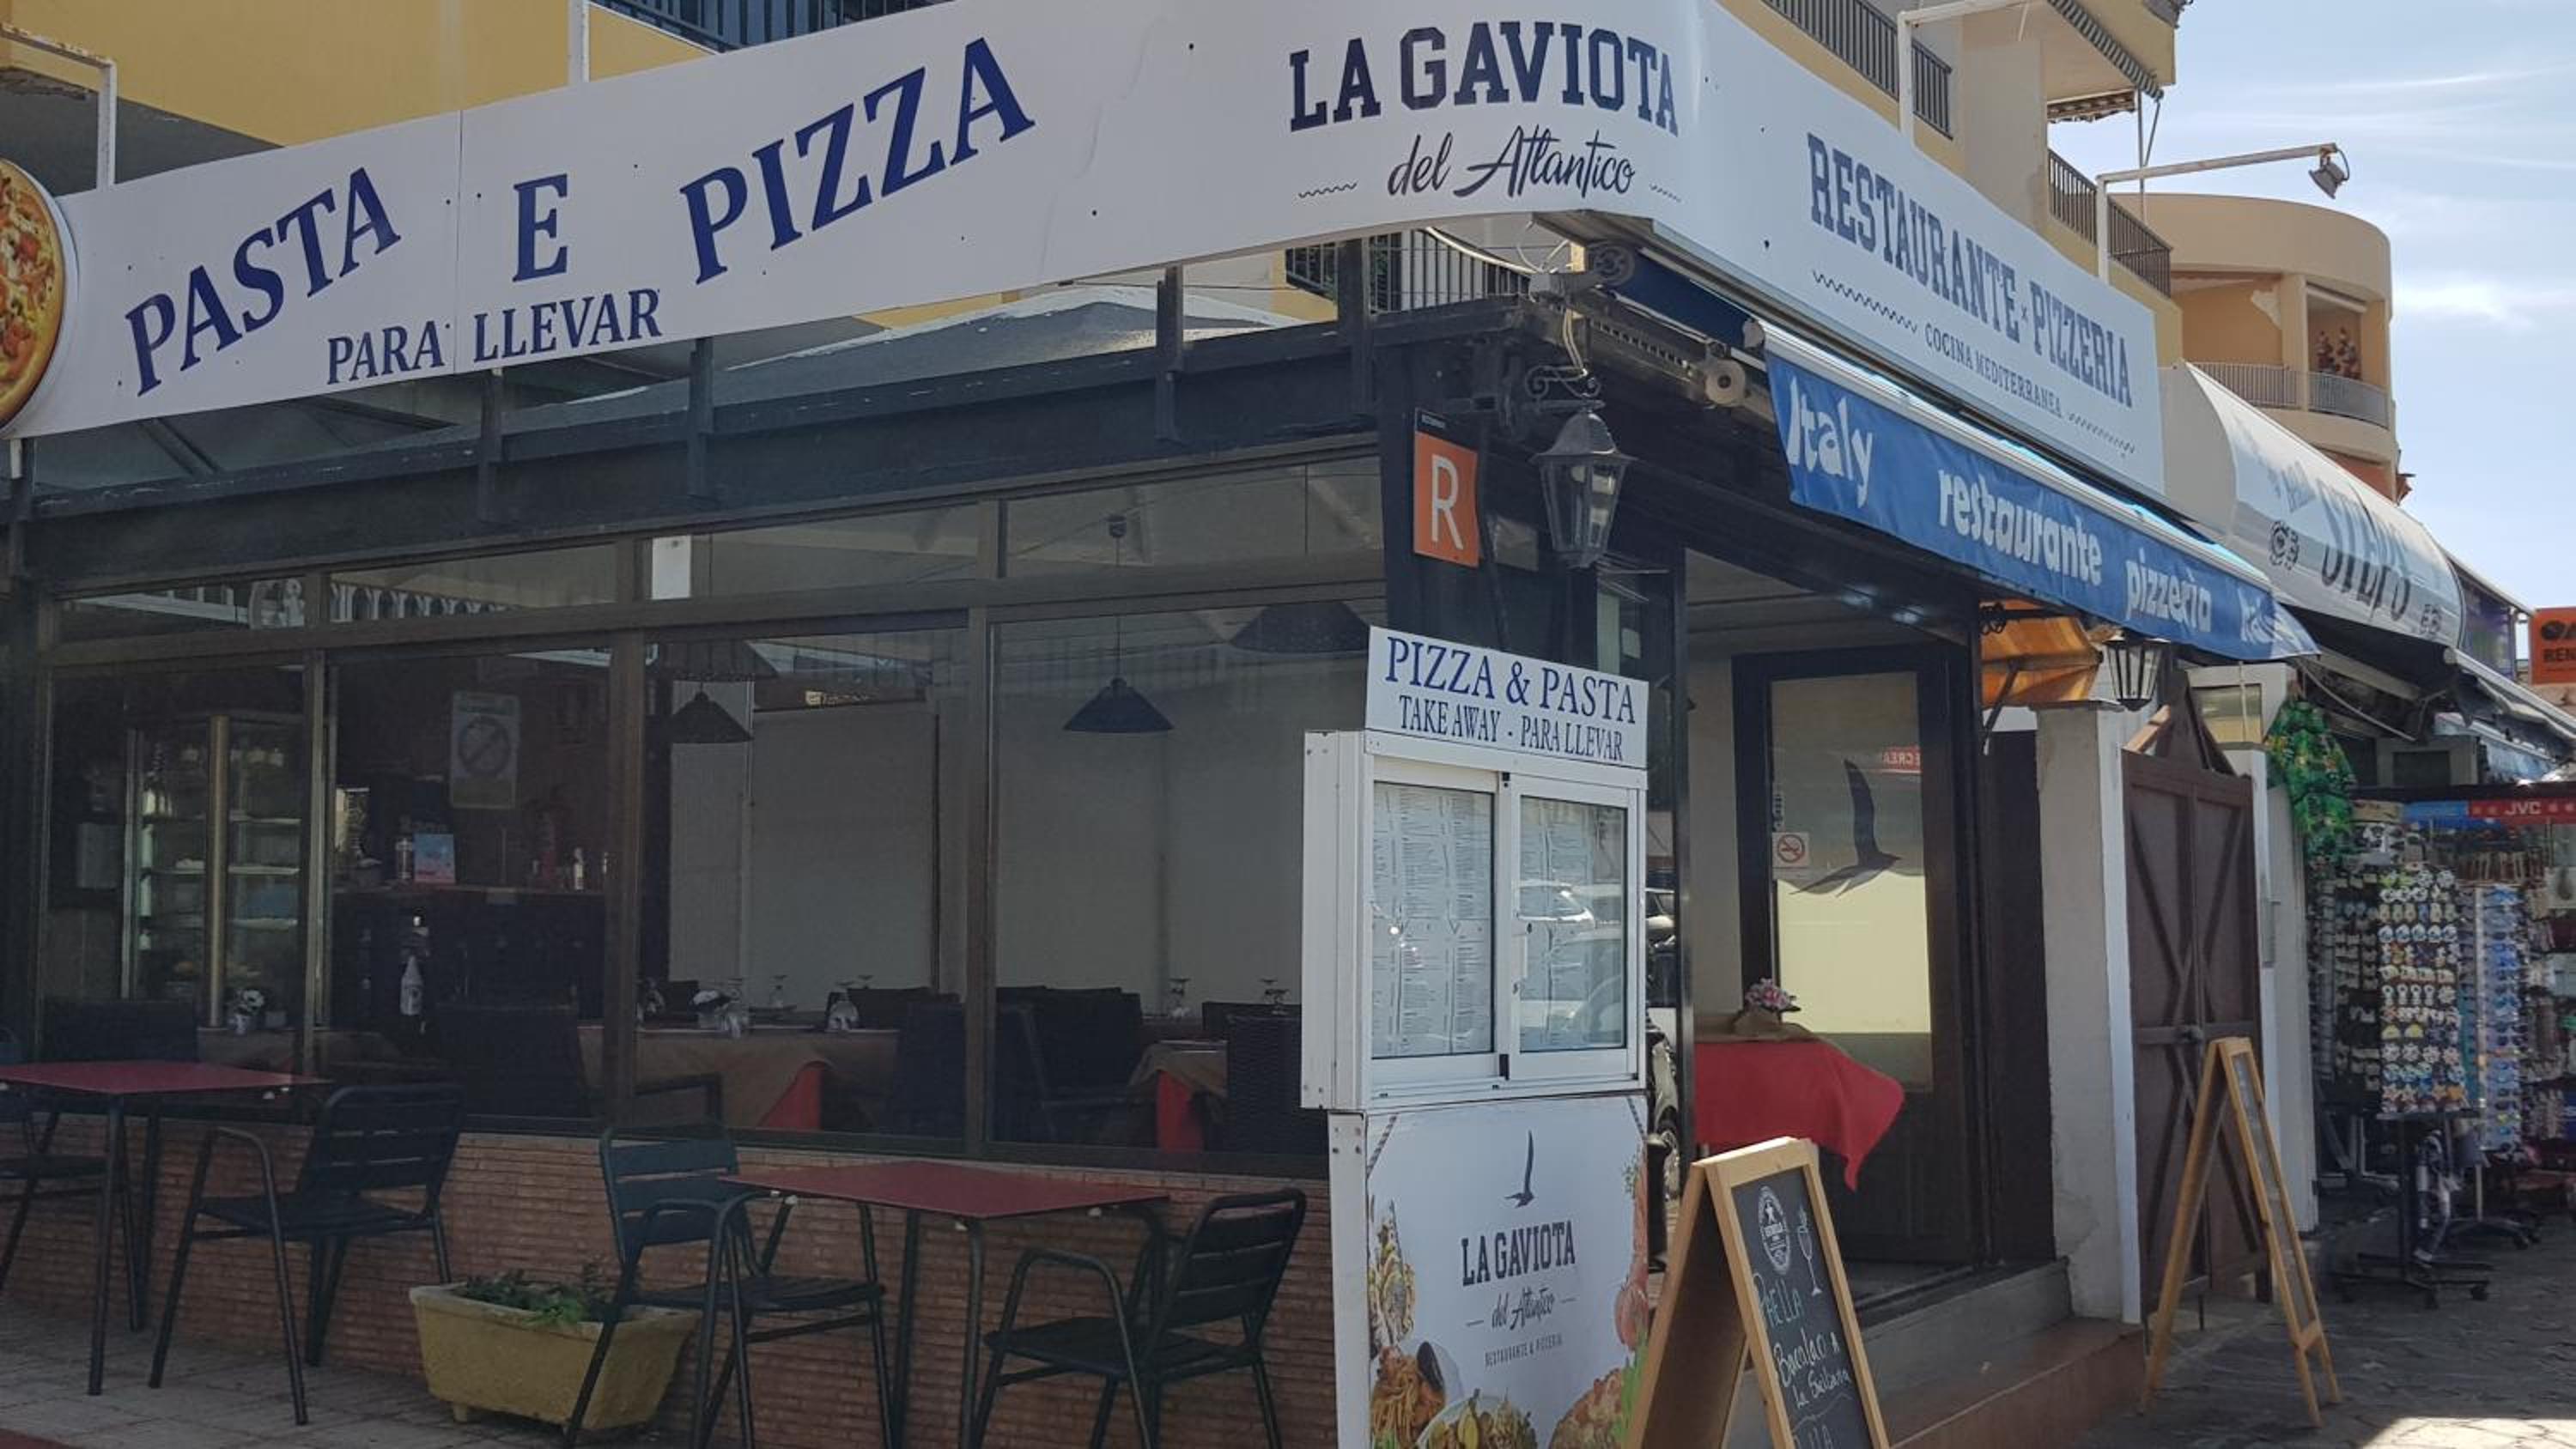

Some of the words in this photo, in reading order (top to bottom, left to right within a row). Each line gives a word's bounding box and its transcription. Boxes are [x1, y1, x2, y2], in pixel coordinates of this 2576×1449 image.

[1289, 38, 1382, 132] LA
[1400, 21, 1679, 137] GAVIOTA
[1387, 133, 1454, 197] del
[125, 167, 401, 398] PASTA
[512, 173, 568, 282] E
[679, 36, 1036, 286] PIZZA
[1807, 132, 2020, 343] RESTAURANTE
[2029, 280, 2134, 409] PIZZERIA
[326, 319, 446, 385] PARA
[473, 287, 662, 363] LLEVAR
[1924, 323, 1974, 369] COCINA
[1431, 452, 1465, 550] R
[1785, 375, 1874, 510] Italy
[1937, 469, 2103, 587] restaurante
[1384, 636, 1496, 700] PIZZA
[1505, 661, 1531, 706] &
[1539, 667, 1636, 724] PASTA
[1400, 694, 1449, 732] TAKE
[1451, 701, 1501, 743] AWAY
[1520, 715, 1559, 752] PARA
[1564, 722, 1623, 761] LLEVAR
[2504, 801, 2543, 816] JVC
[1461, 1237, 1491, 1287] LA
[1495, 1220, 1576, 1280] GAVIOTA
